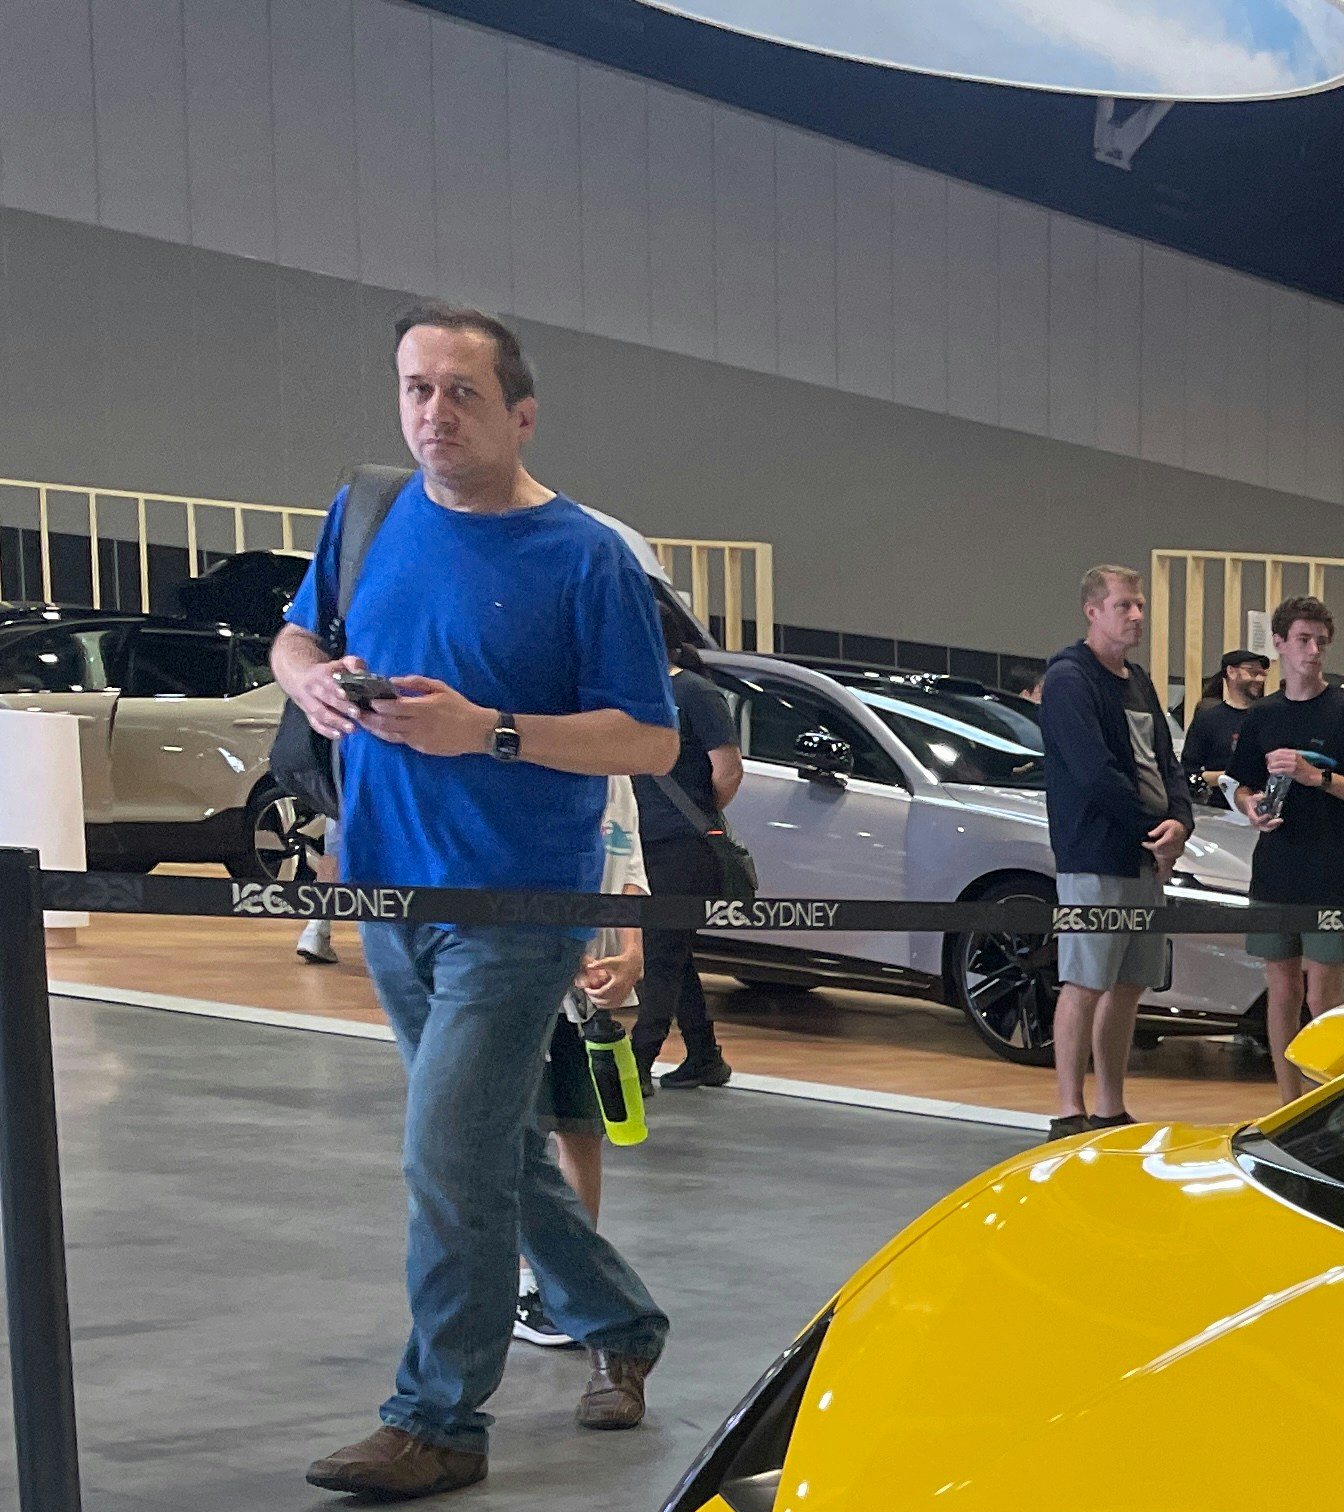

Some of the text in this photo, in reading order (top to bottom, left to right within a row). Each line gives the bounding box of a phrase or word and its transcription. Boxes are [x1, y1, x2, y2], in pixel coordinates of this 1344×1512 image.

[297, 885, 414, 918] SYDNEY
[752, 901, 840, 927] SYDNEY
[1088, 908, 1155, 931] SYDNEY
